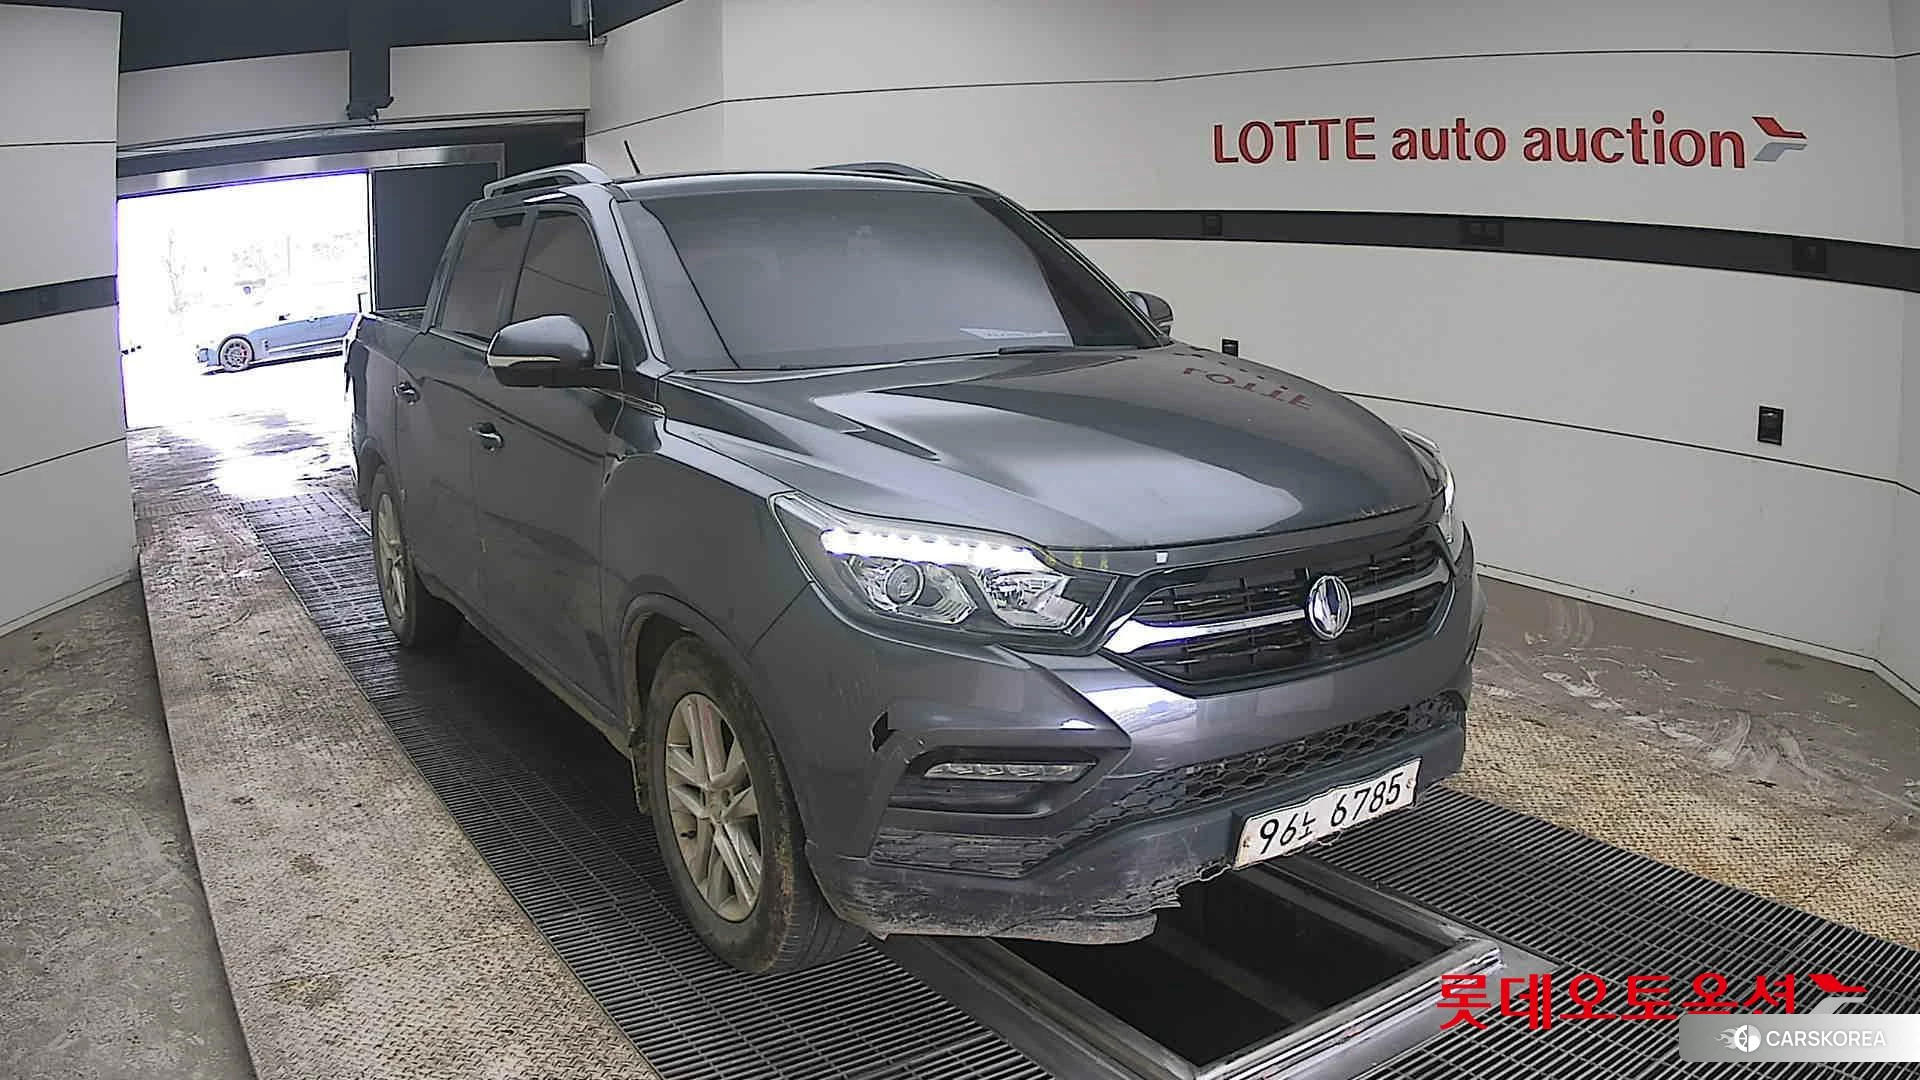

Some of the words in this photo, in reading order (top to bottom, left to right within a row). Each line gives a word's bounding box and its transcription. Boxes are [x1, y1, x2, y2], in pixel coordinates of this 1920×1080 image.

[1213, 117, 1376, 163] LOTTE
[1391, 117, 1506, 162] auto
[1523, 110, 1746, 168] auction
[1259, 811, 1316, 855] 96노
[1330, 771, 1404, 828] 6785
